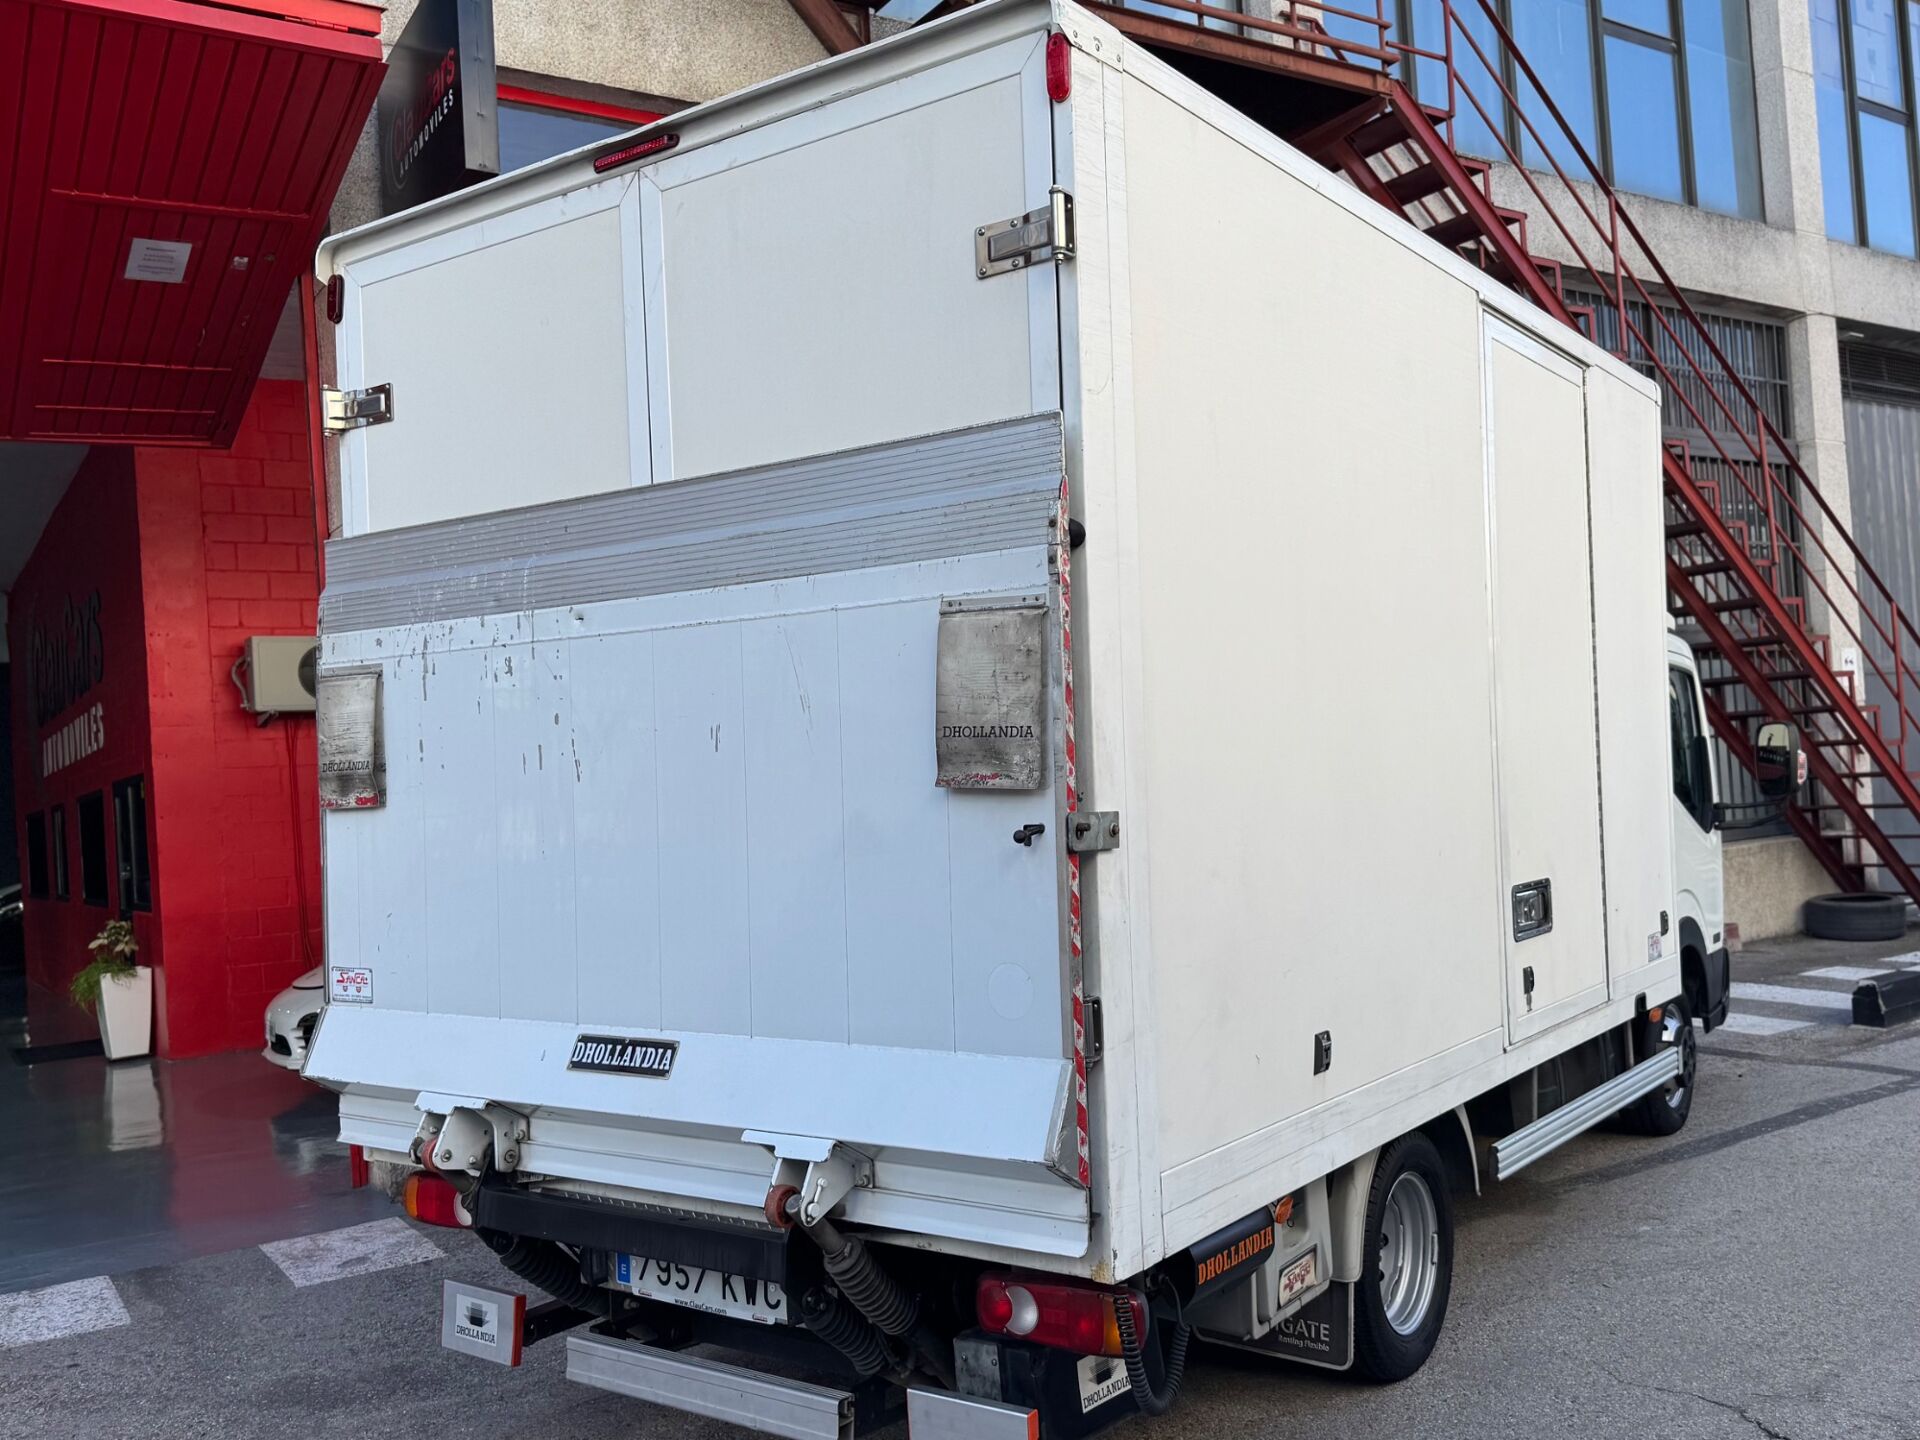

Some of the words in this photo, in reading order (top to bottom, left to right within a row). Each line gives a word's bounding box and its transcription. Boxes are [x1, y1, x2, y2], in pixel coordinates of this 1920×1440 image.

[399, 88, 454, 178] AUTOMOVILES
[942, 725, 1035, 738] DHOLLANDIA
[322, 760, 370, 773] DHOLLANDIA
[571, 1042, 673, 1070] DHOLLANDIA
[1198, 1226, 1274, 1286] DHOLLANDIA
[621, 1263, 627, 1275] E
[674, 1298, 728, 1315] www.ClauCars.com
[456, 1325, 496, 1344] DHOLLANDIA
[1082, 1375, 1132, 1409] DHOLLANDIA
